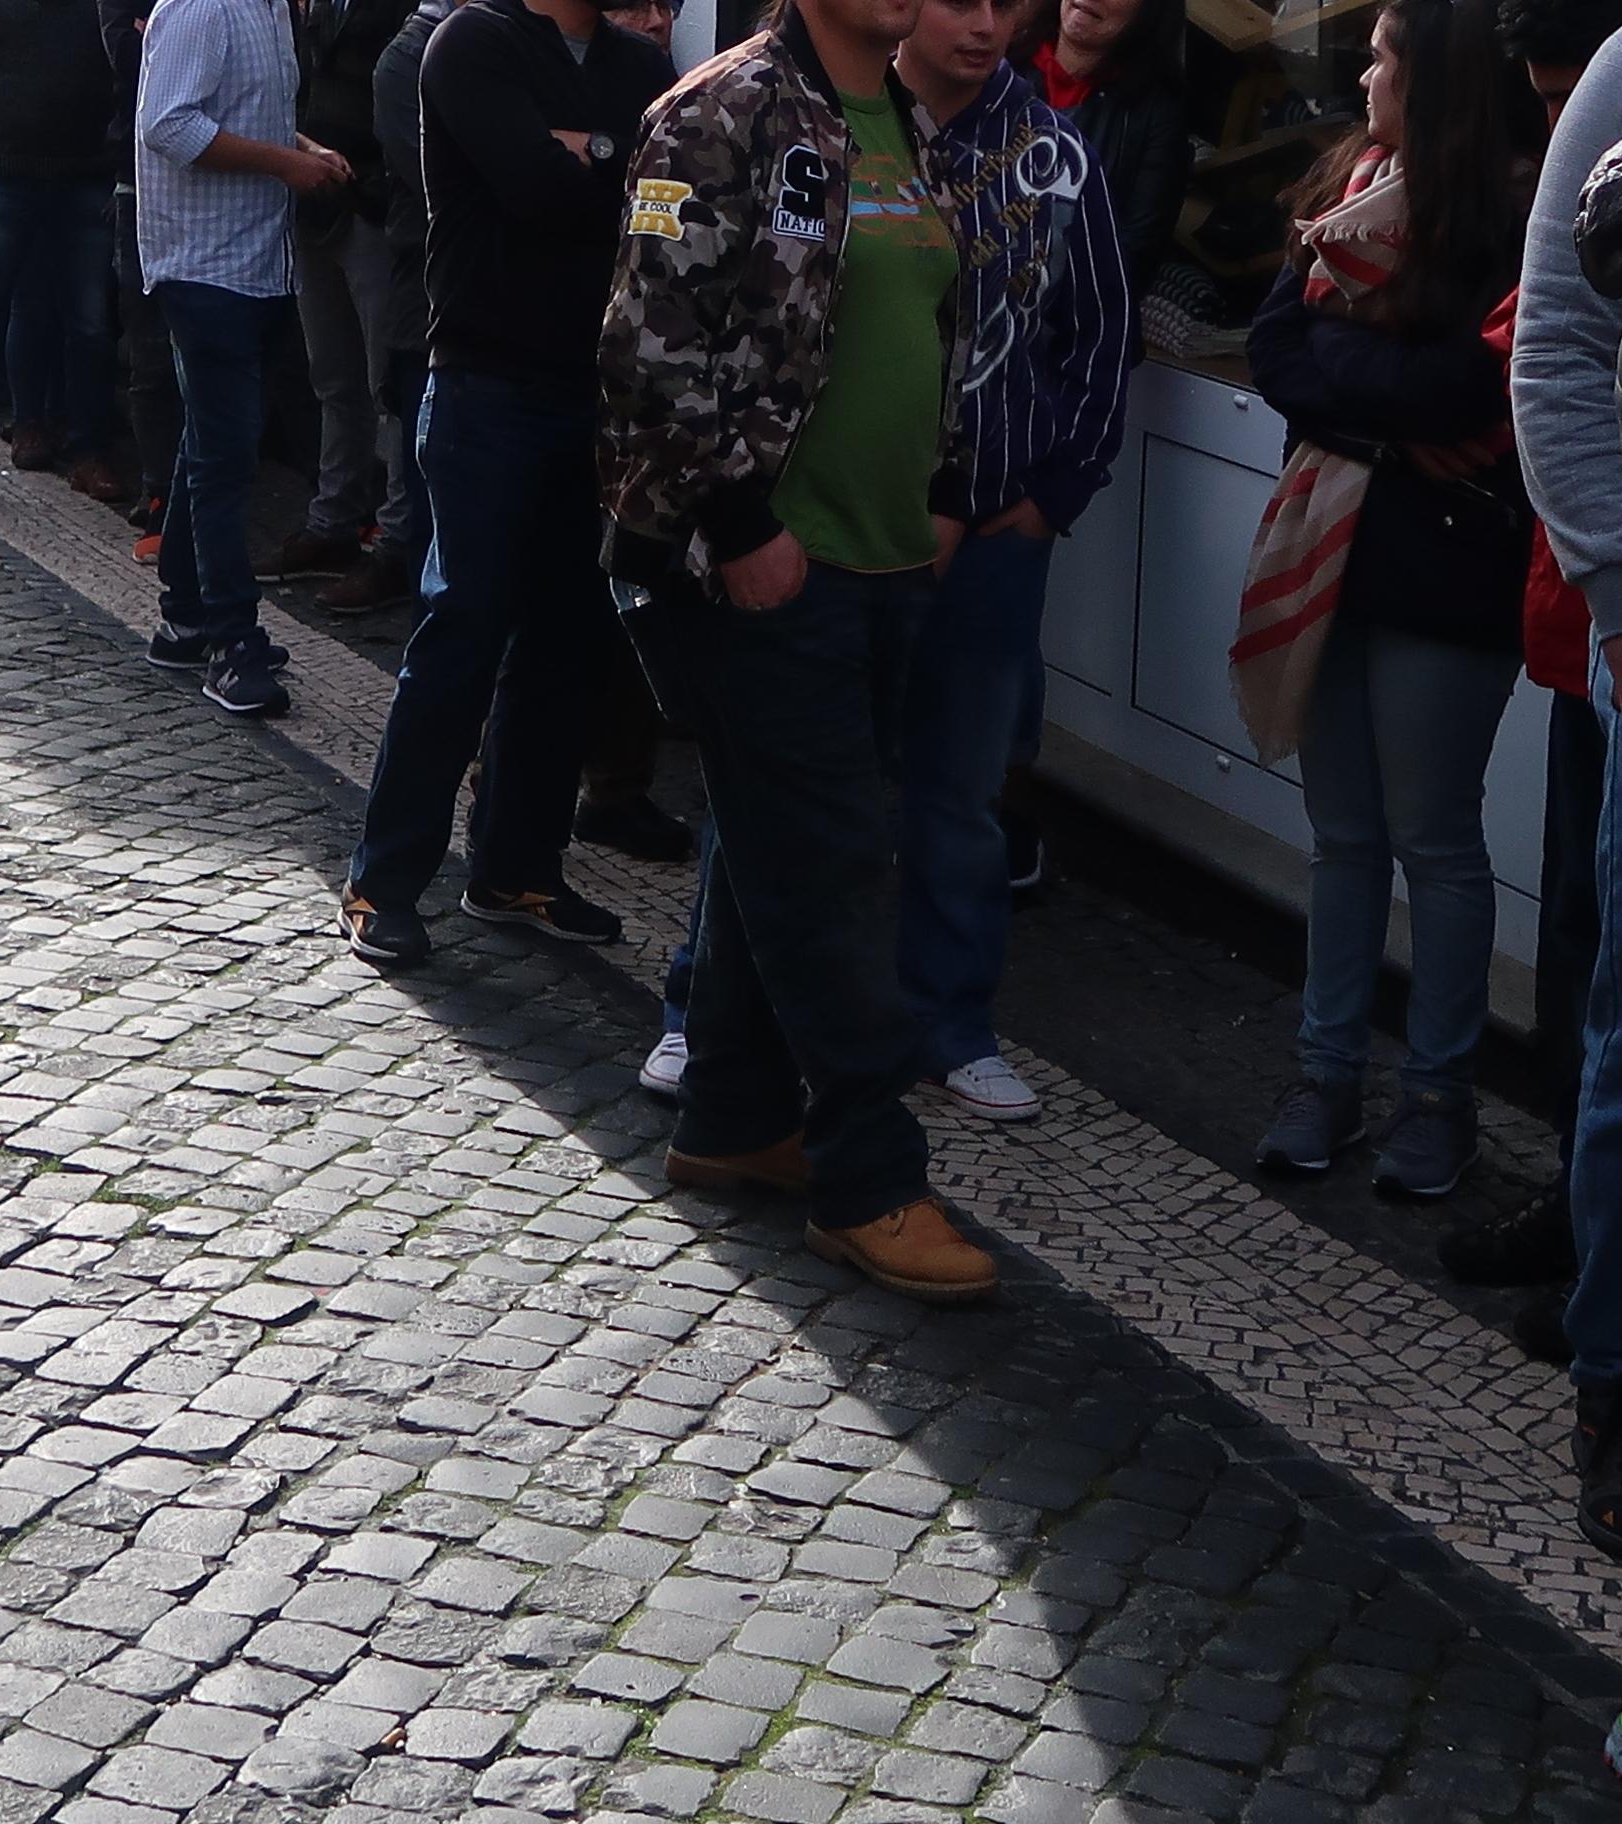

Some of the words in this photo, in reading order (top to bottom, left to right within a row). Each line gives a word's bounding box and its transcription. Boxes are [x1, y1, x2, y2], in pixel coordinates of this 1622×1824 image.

[638, 201, 649, 212] BE
[650, 201, 672, 215] COOL
[778, 211, 826, 237] NATIO
